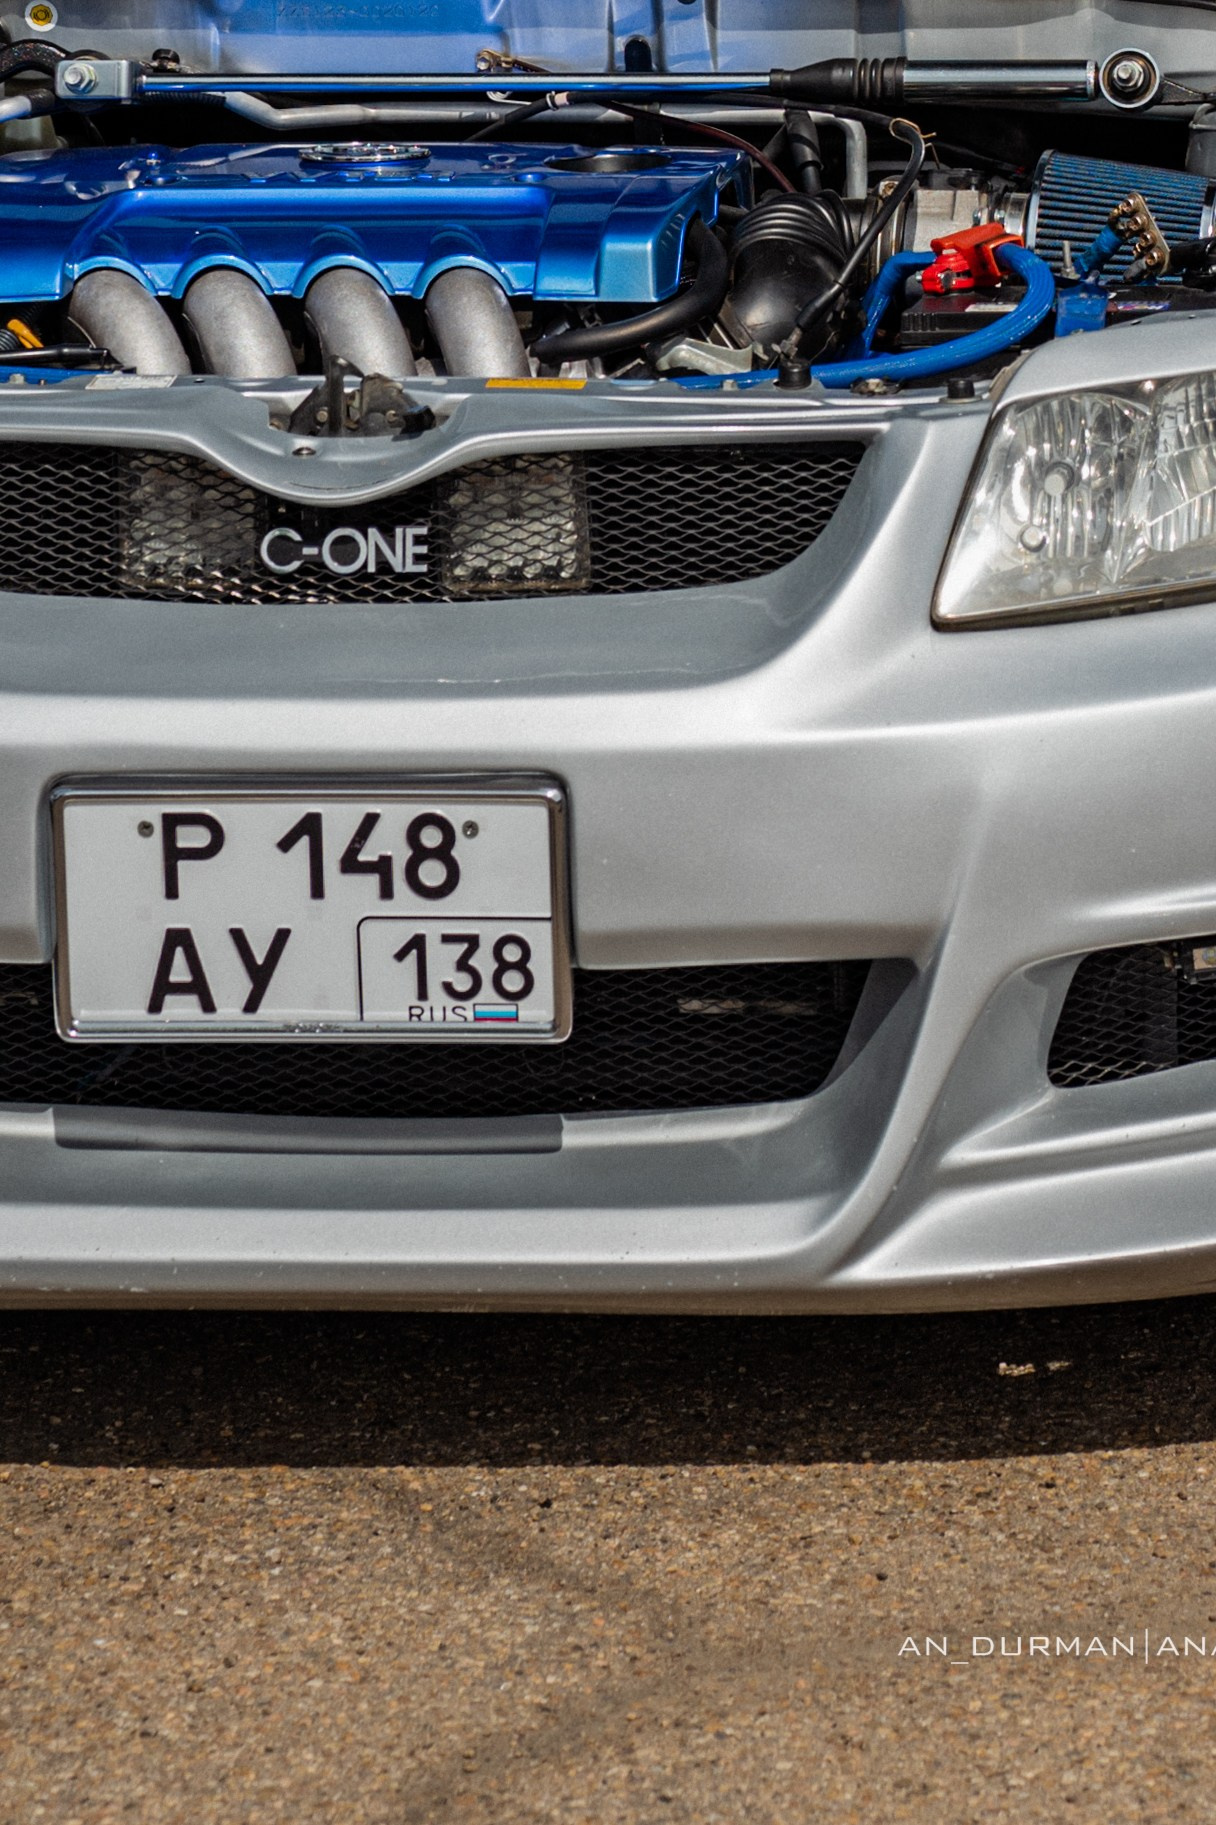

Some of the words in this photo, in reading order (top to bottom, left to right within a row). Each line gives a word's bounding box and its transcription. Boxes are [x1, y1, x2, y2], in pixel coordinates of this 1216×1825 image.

[260, 527, 428, 574] C-ONE
[275, 811, 461, 900] 148
[146, 927, 292, 1014] АУ
[393, 933, 534, 1002] 138
[408, 1004, 468, 1023] RUS
